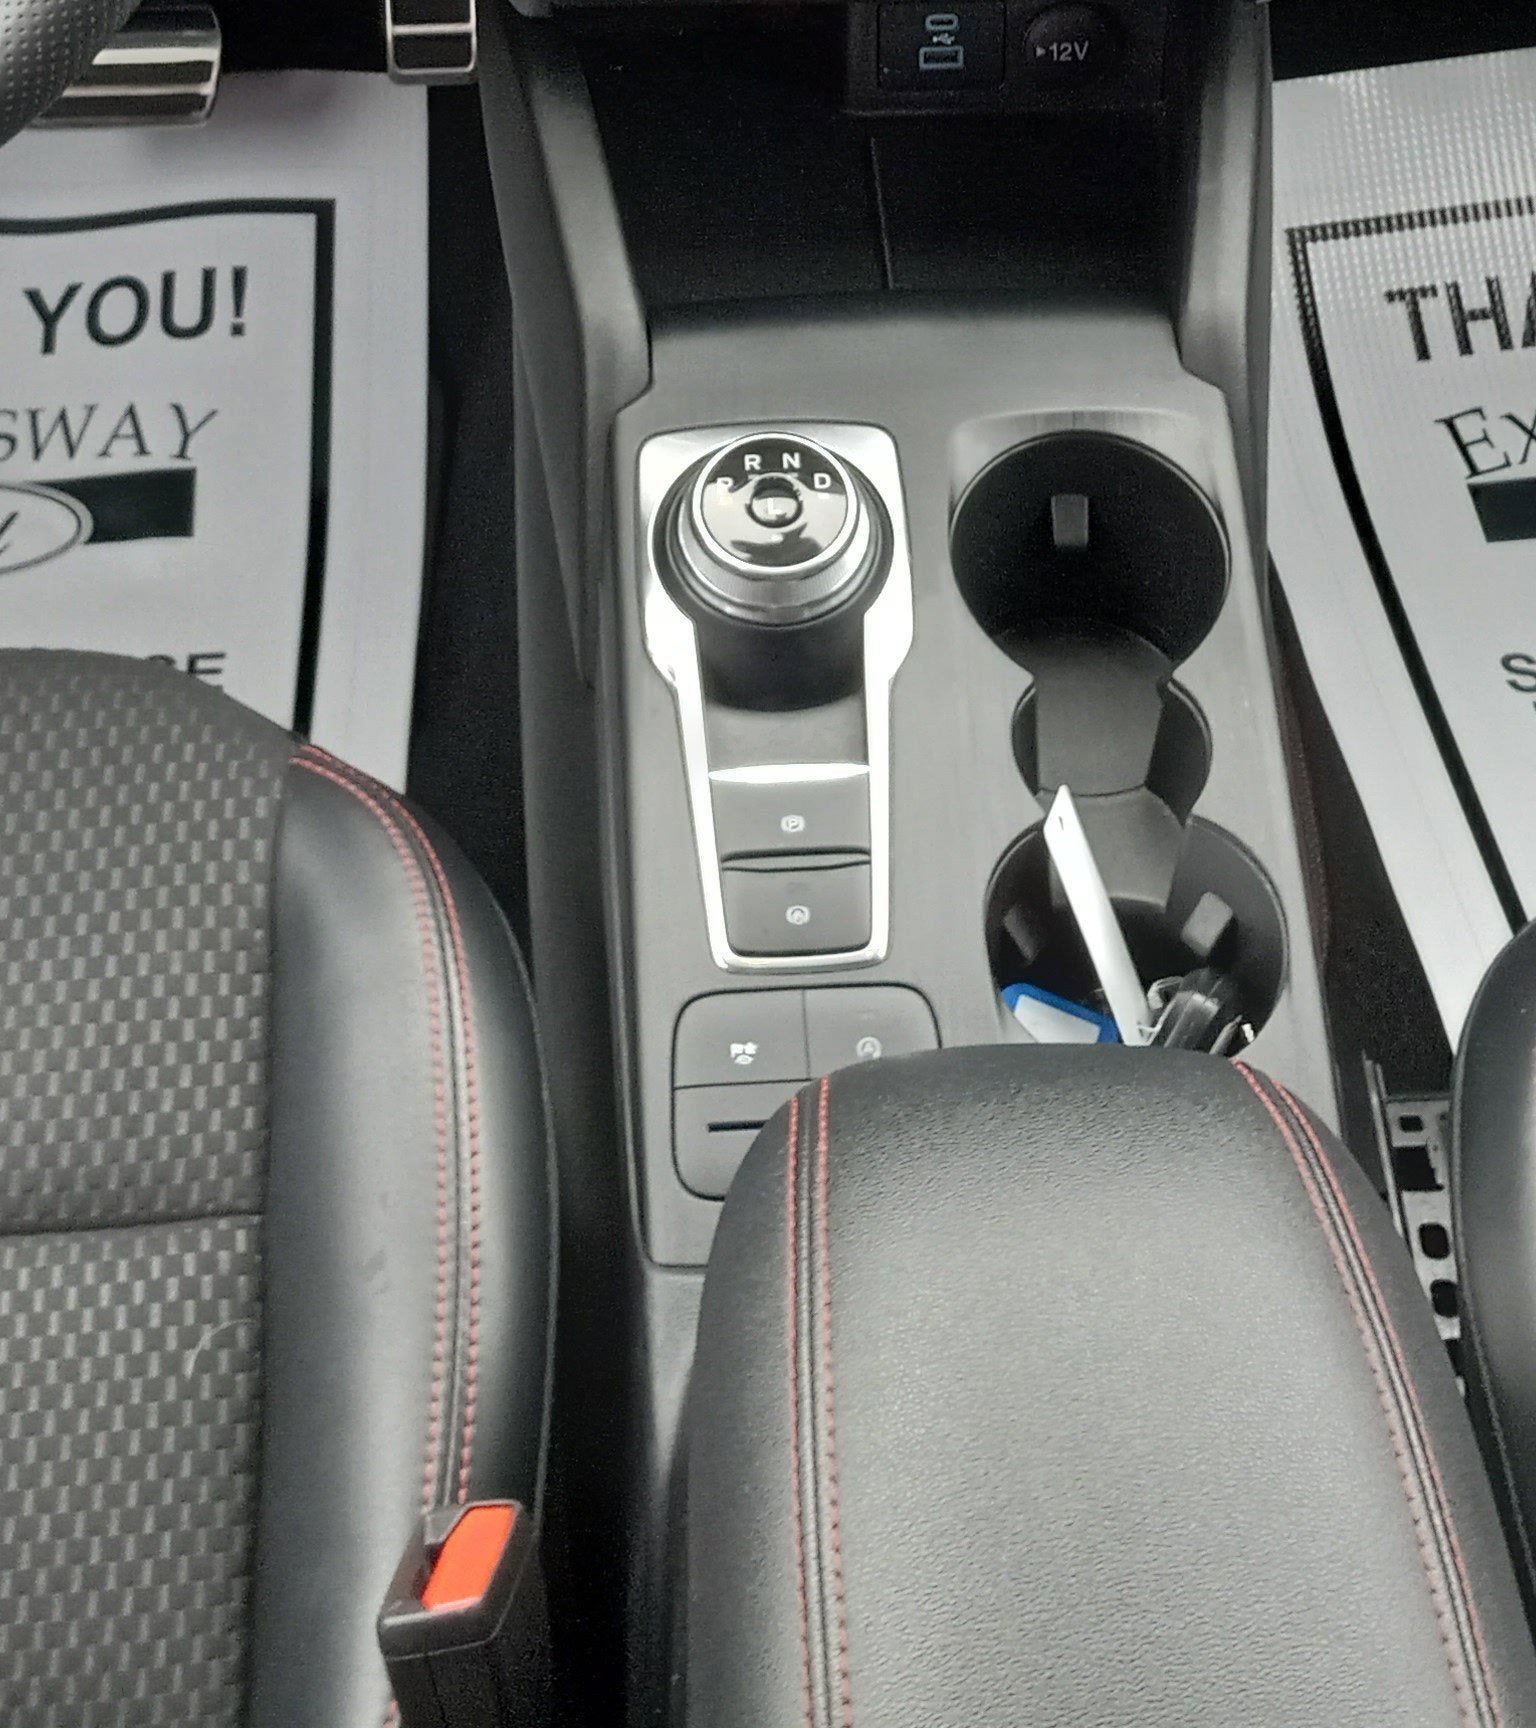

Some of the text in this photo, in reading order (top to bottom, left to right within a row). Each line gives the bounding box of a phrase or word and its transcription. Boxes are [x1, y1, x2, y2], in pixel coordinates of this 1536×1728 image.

[1049, 40, 1090, 62] 12V
[23, 264, 250, 356] YOU!
[743, 452, 802, 471] R N
[814, 472, 832, 490] D
